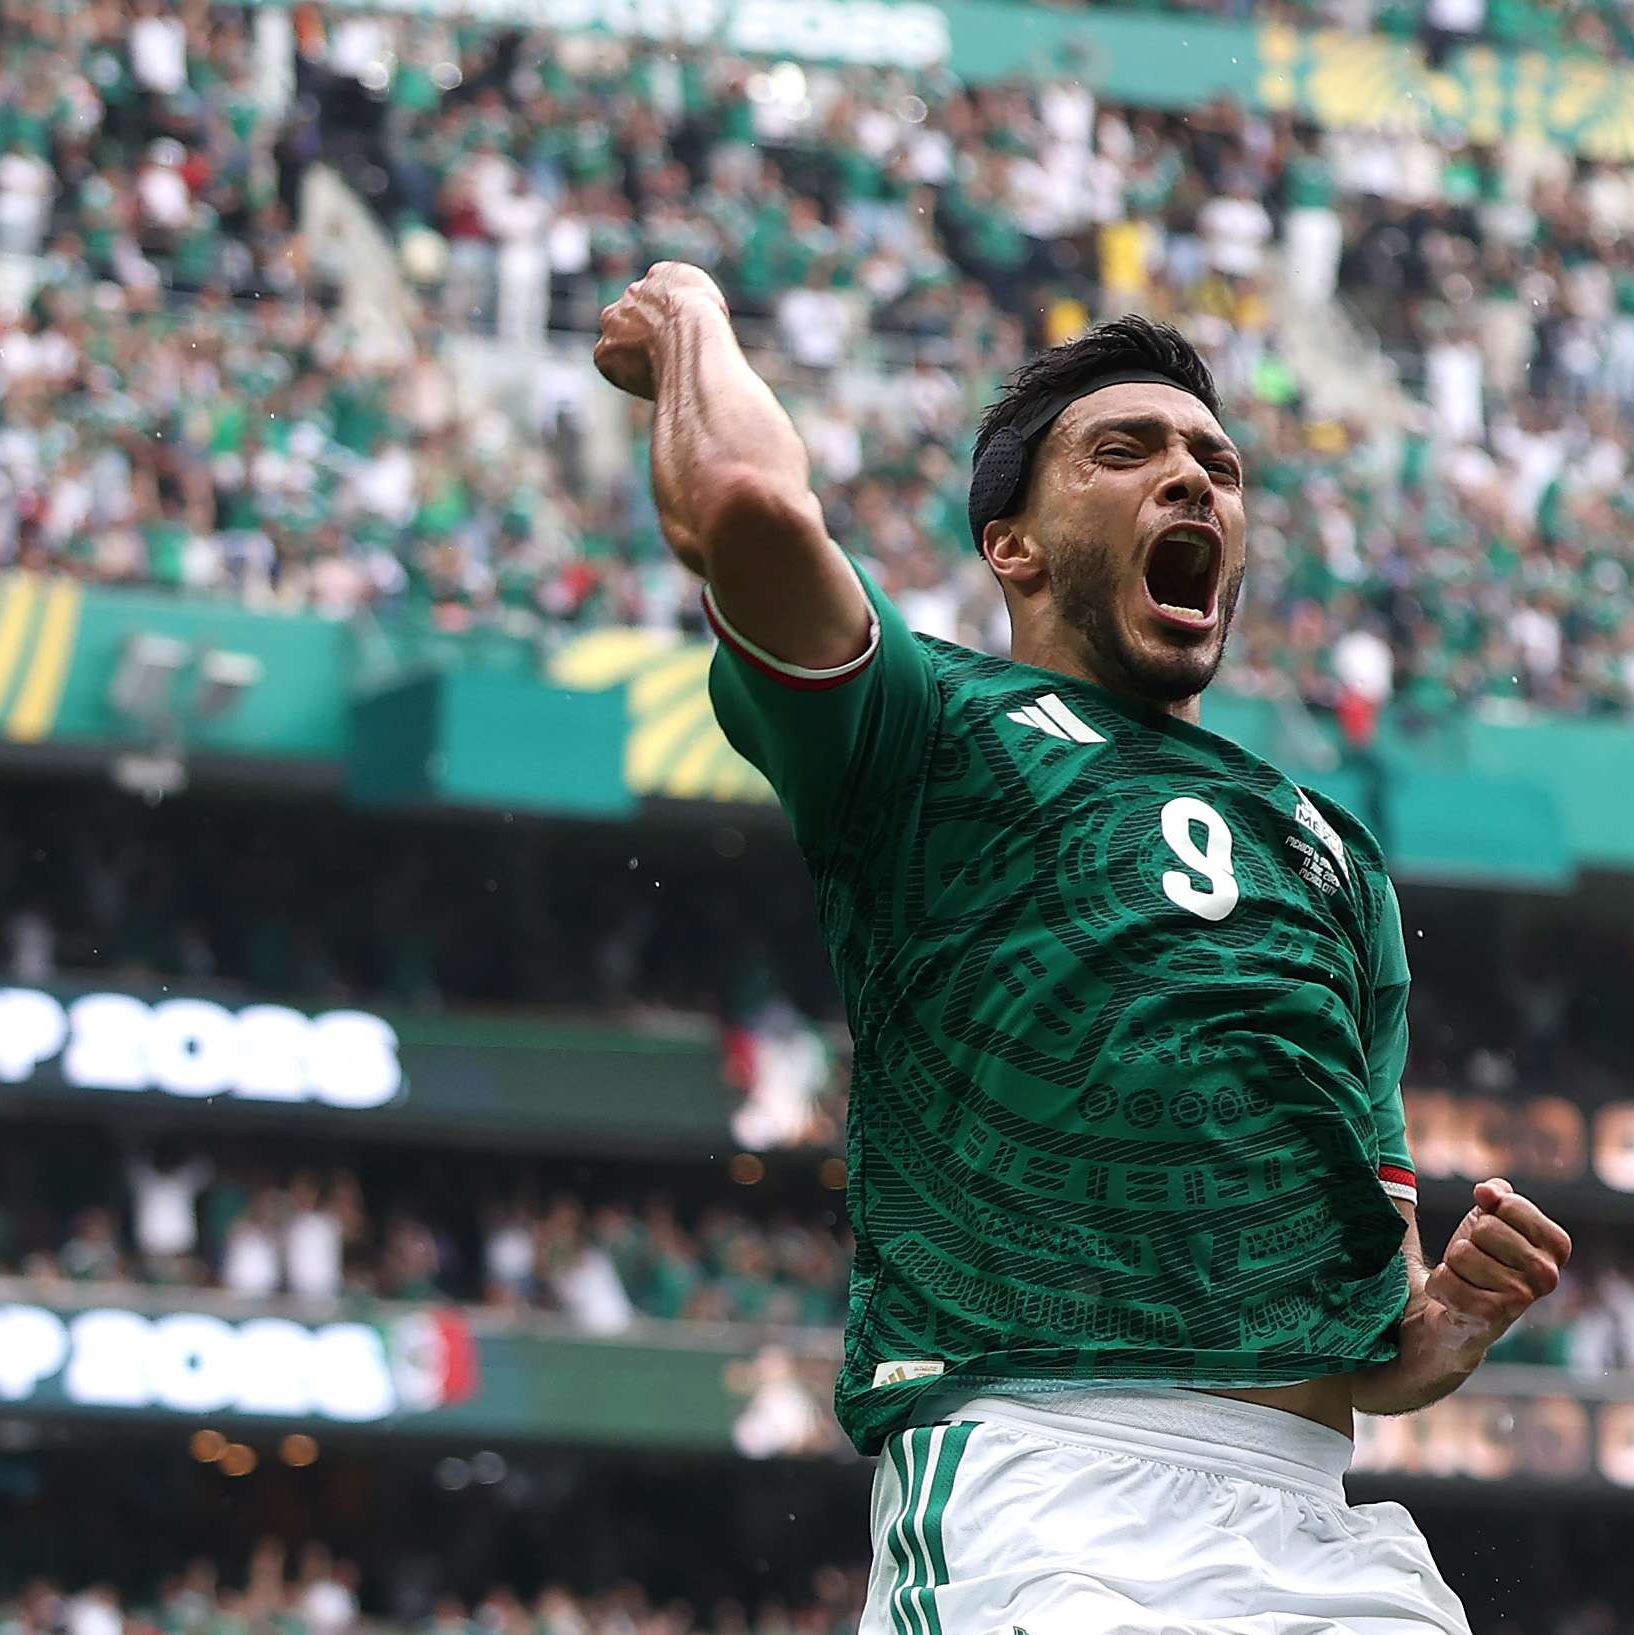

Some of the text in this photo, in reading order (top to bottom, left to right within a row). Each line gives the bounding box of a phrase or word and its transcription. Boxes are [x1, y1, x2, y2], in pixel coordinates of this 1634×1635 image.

[1160, 796, 1239, 921] 9
[64, 993, 401, 1109] 2026
[65, 1309, 398, 1420] 2026
